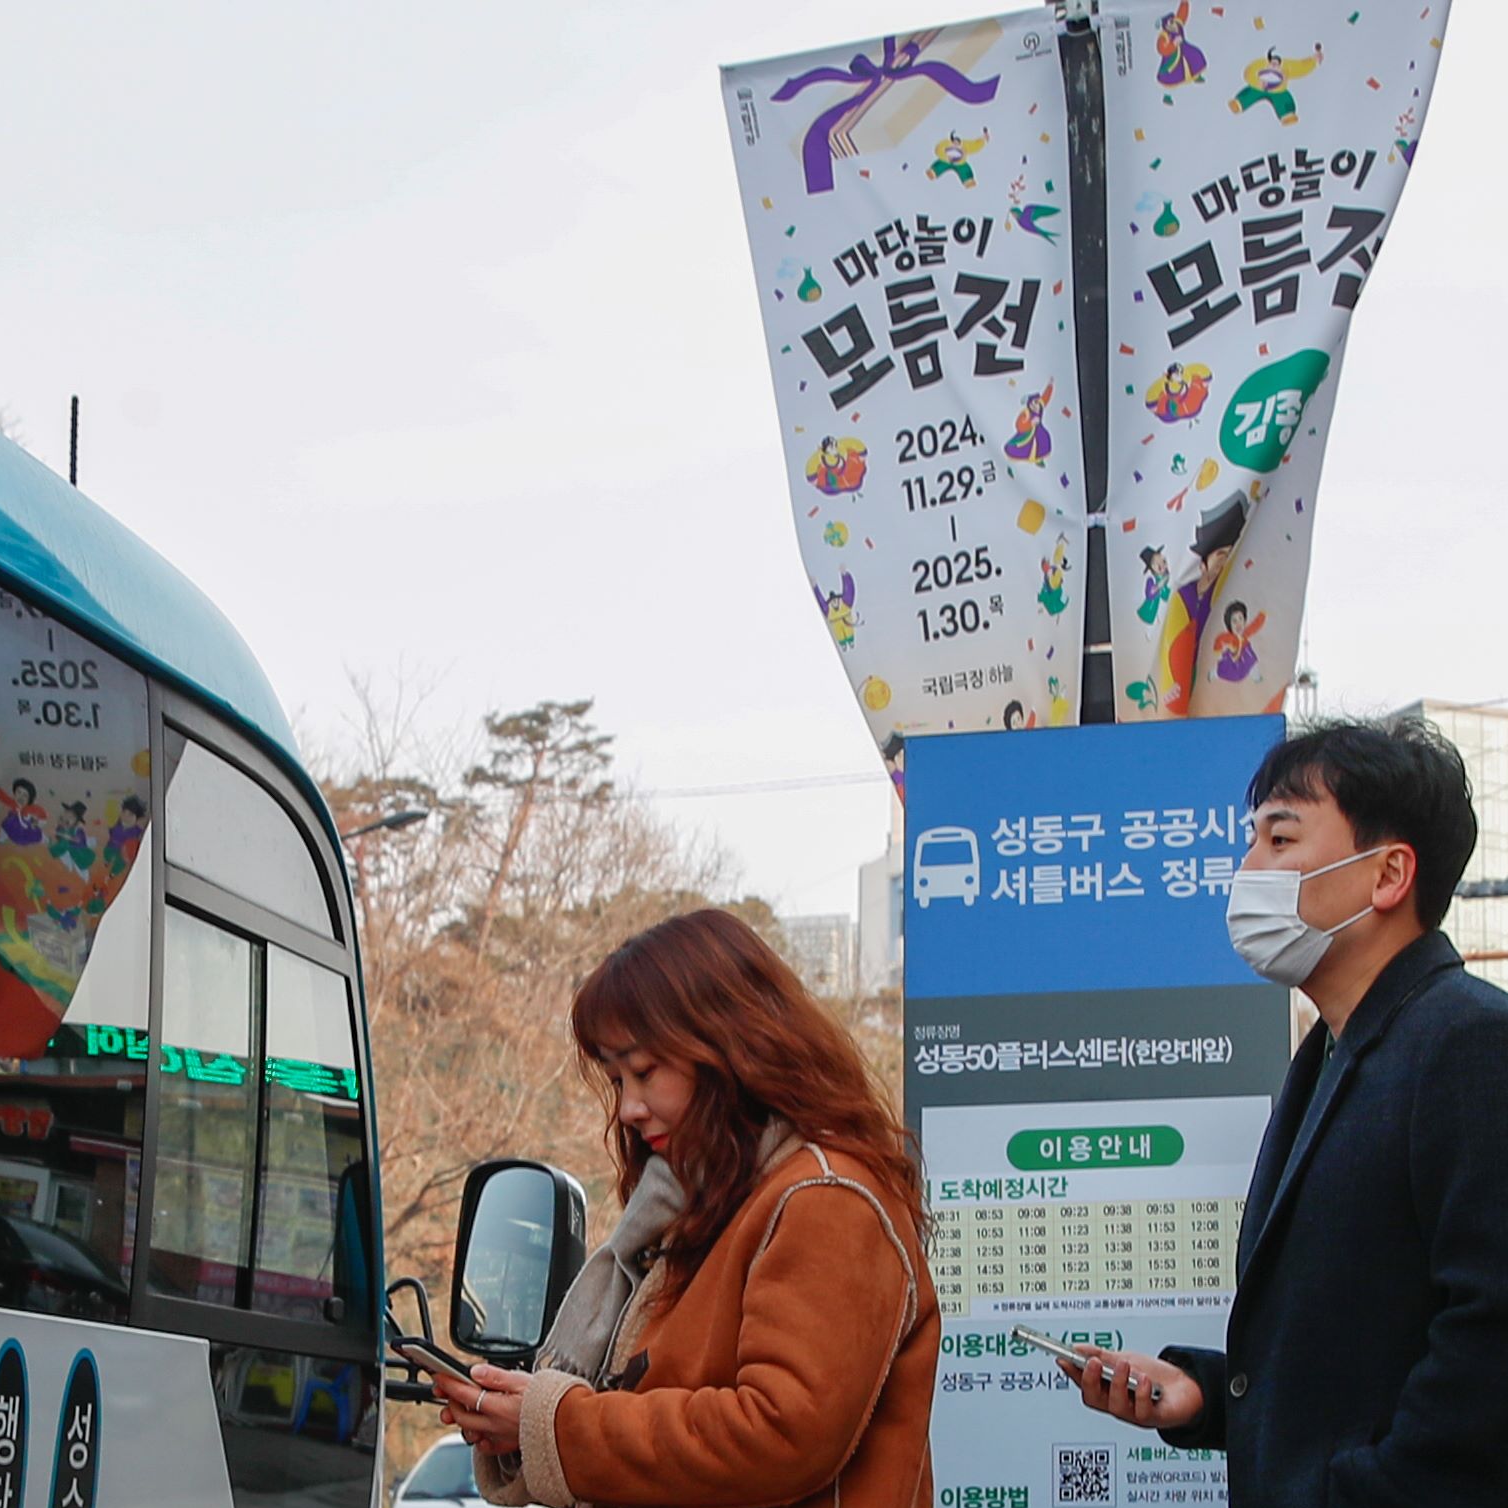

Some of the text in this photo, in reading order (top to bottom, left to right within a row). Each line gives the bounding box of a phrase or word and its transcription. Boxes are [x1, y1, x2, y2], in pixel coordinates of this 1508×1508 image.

[1192, 148, 1377, 223] 마당놀이
[833, 214, 993, 287] 마당놀이
[801, 272, 1041, 411] 모듬전
[896, 414, 985, 463] 2024.
[912, 546, 1002, 594] 2025.
[992, 814, 1105, 856] 성동구
[991, 856, 1242, 906] 셔틀버스 정류
[914, 1036, 1233, 1075] 성동50플러스센터(한양대앞)
[1040, 1134, 1152, 1163] 이용안내
[939, 1176, 1068, 1201] 도착예정시간
[975, 1209, 1003, 1221] 08:53
[1018, 1208, 1046, 1220] 09:08
[1061, 1206, 1089, 1218] 09:23
[1103, 1204, 1131, 1216] 09:38
[1146, 1203, 1175, 1215] 09:53
[1191, 1201, 1219, 1213] 10:08
[976, 1227, 1004, 1239] 10:53
[1019, 1226, 1046, 1238] 11:08
[1062, 1224, 1089, 1236] 11:23
[1105, 1223, 1132, 1235] 11:38
[1148, 1221, 1175, 1234] 11:53
[1191, 1220, 1219, 1232] 12:08
[976, 1246, 1004, 1257] 12:53
[1019, 1244, 1046, 1256] 13:08
[1062, 1243, 1089, 1255] 13:23
[1105, 1241, 1132, 1253] 13:38
[1148, 1240, 1176, 1252] 13:53
[1191, 1238, 1219, 1250] 14:08
[935, 1257, 1219, 1277] 14:38 14:53 15:08 15:23 15:38 15:53 16:08
[977, 1282, 1004, 1294] 16:53
[1019, 1281, 1047, 1293] 17:08
[1062, 1279, 1090, 1291] 17:23
[1105, 1278, 1133, 1290] 17:38
[1148, 1277, 1176, 1289] 17:53
[1192, 1275, 1220, 1287] 18:08
[941, 1302, 962, 1313] 8:31
[942, 1333, 1051, 1357] 이용대상
[941, 1371, 1070, 1392] 성동구 공공시설
